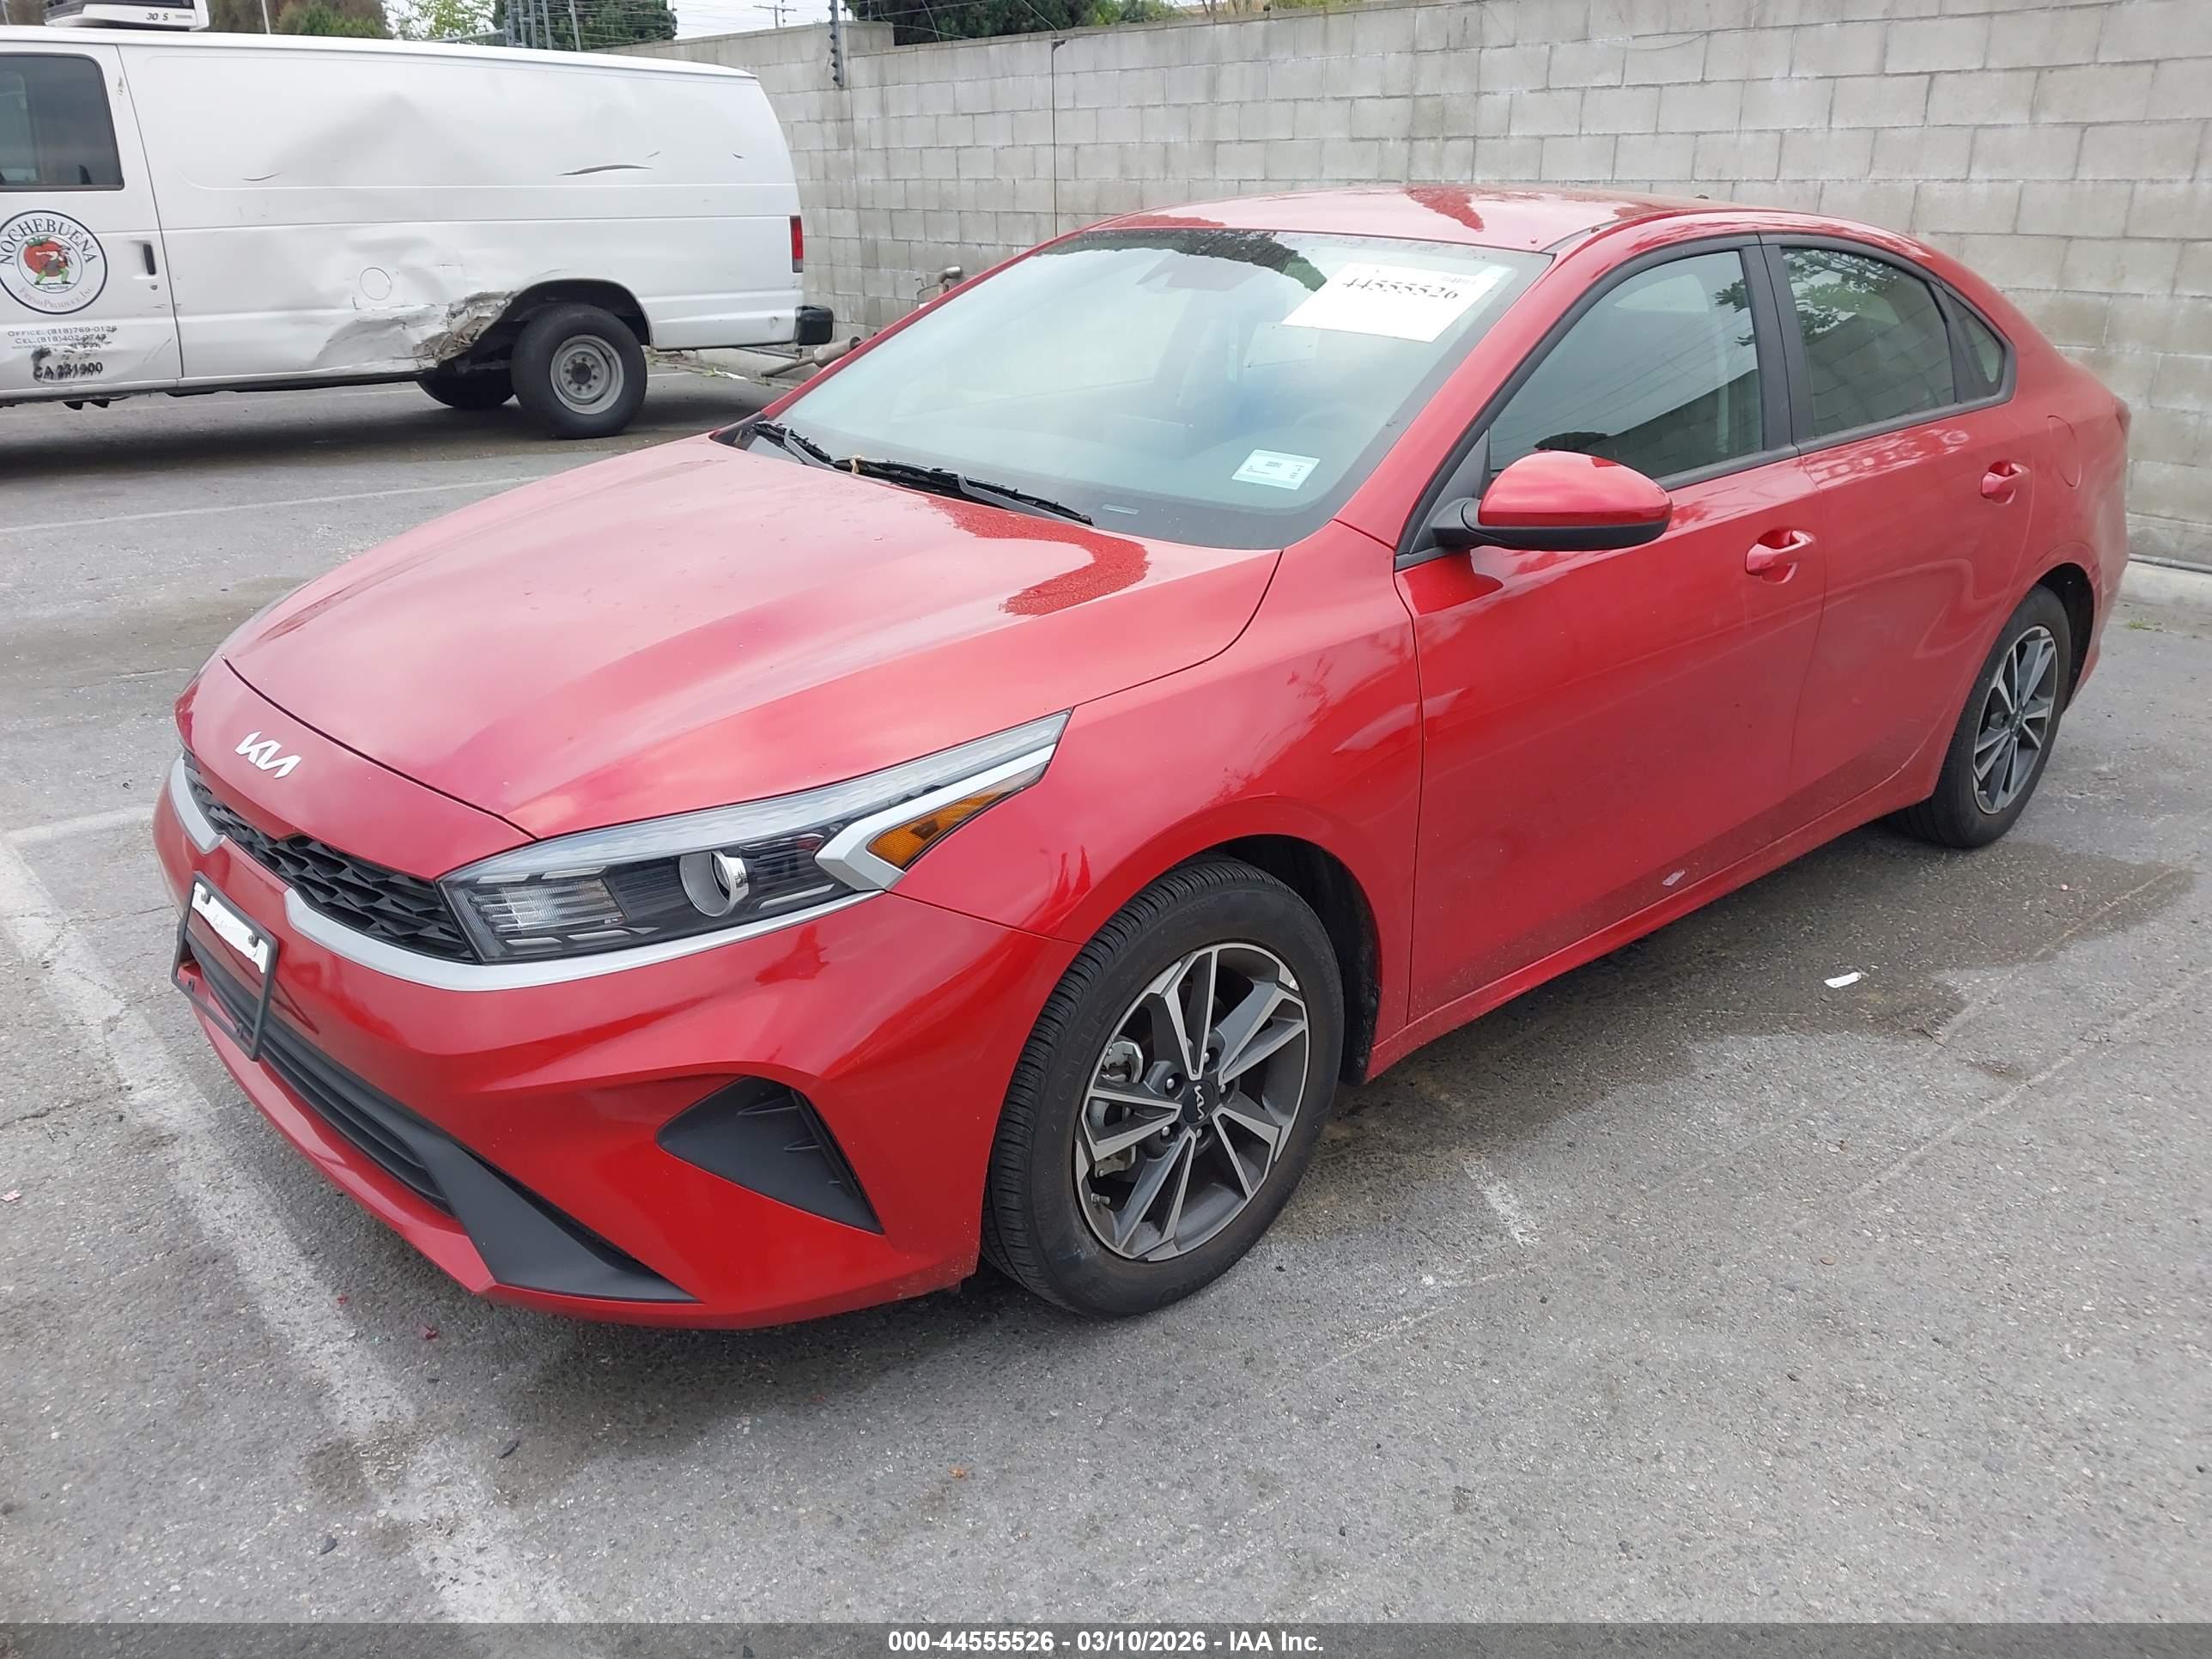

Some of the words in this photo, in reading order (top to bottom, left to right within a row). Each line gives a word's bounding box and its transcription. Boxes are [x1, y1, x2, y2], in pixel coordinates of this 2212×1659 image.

[145, 12, 159, 21] 30
[0, 218, 98, 266] NOCHEBUENA
[1341, 276, 1459, 300] 44555526
[234, 730, 302, 780] KIA
